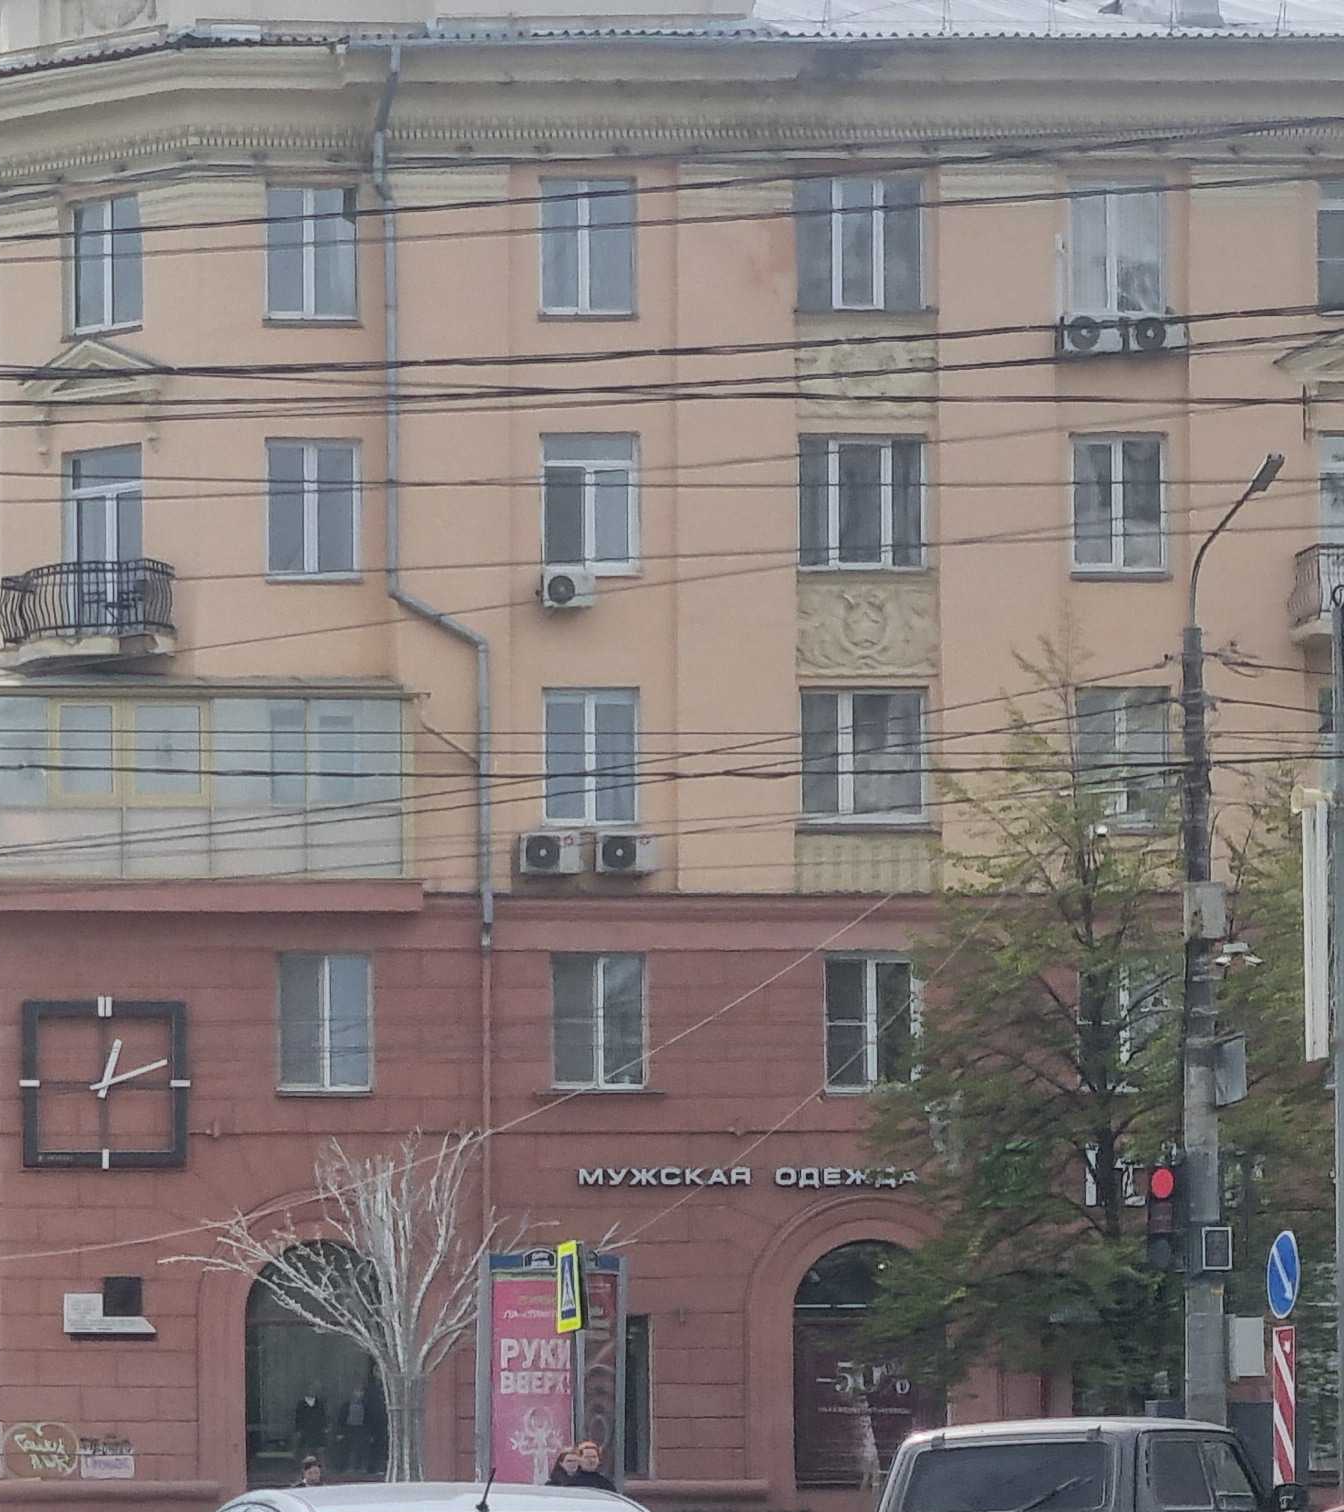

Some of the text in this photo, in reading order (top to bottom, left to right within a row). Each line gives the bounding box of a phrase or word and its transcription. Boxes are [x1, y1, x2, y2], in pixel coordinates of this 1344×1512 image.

[577, 1166, 918, 1188] МУЖСКАЯ ОДЕЖДА
[500, 1338, 571, 1369] РУКИ
[500, 1371, 571, 1395] ВВЕРХ!
